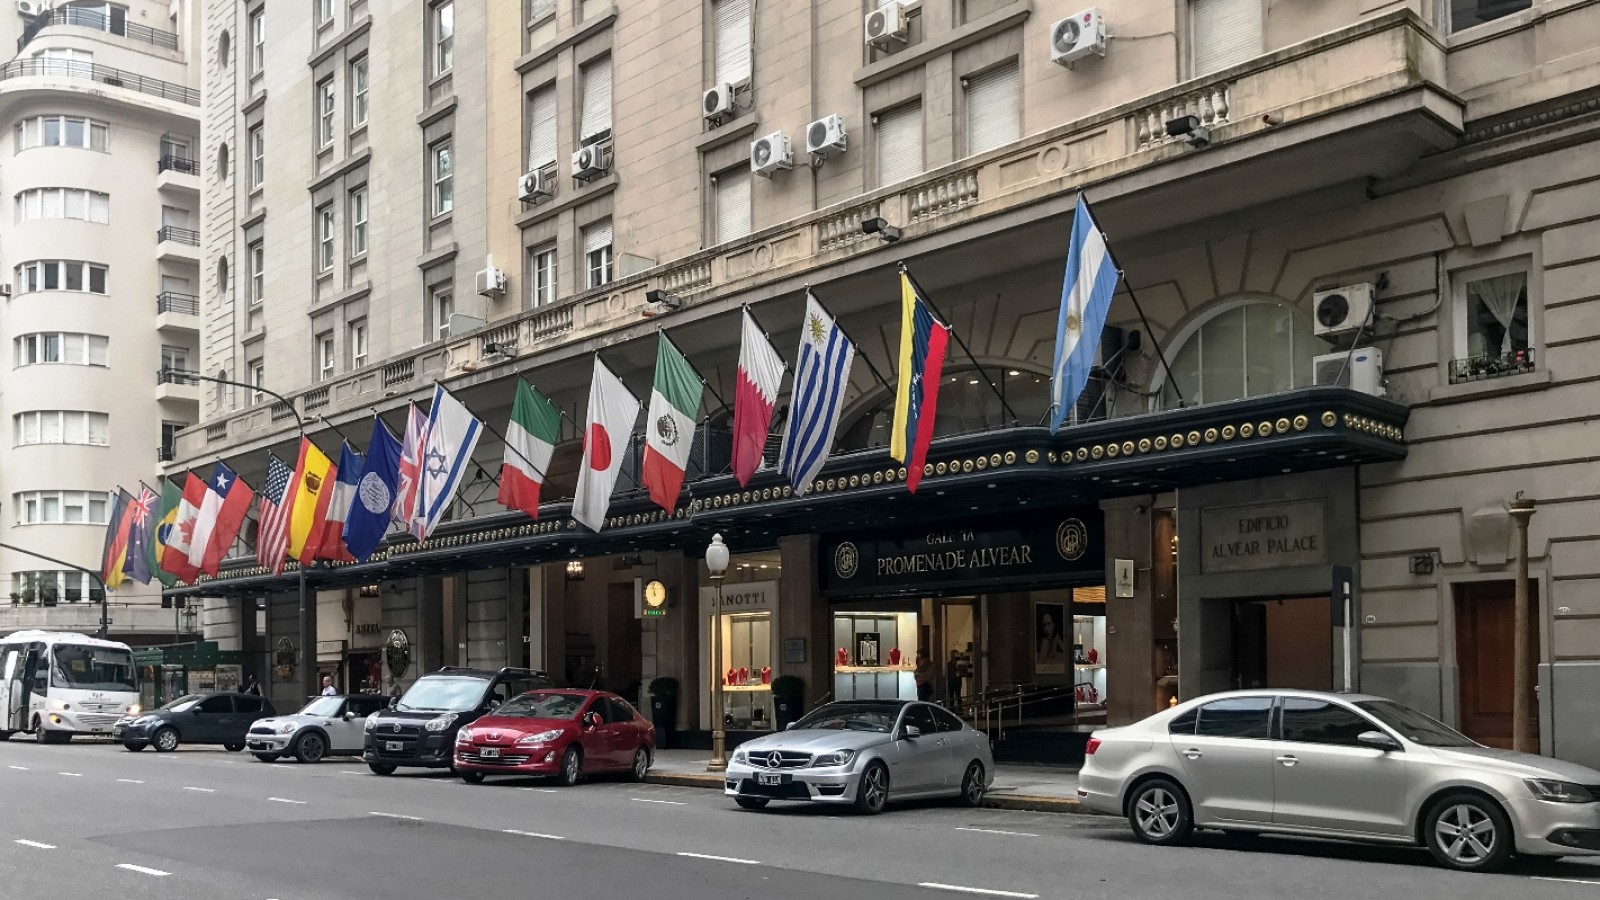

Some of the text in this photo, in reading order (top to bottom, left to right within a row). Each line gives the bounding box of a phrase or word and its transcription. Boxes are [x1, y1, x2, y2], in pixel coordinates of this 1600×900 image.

[1239, 514, 1289, 533] EDIFICIO
[1212, 534, 1318, 558] ALVEAR PALACE
[877, 544, 1032, 576] PROMENADE ALVEAR
